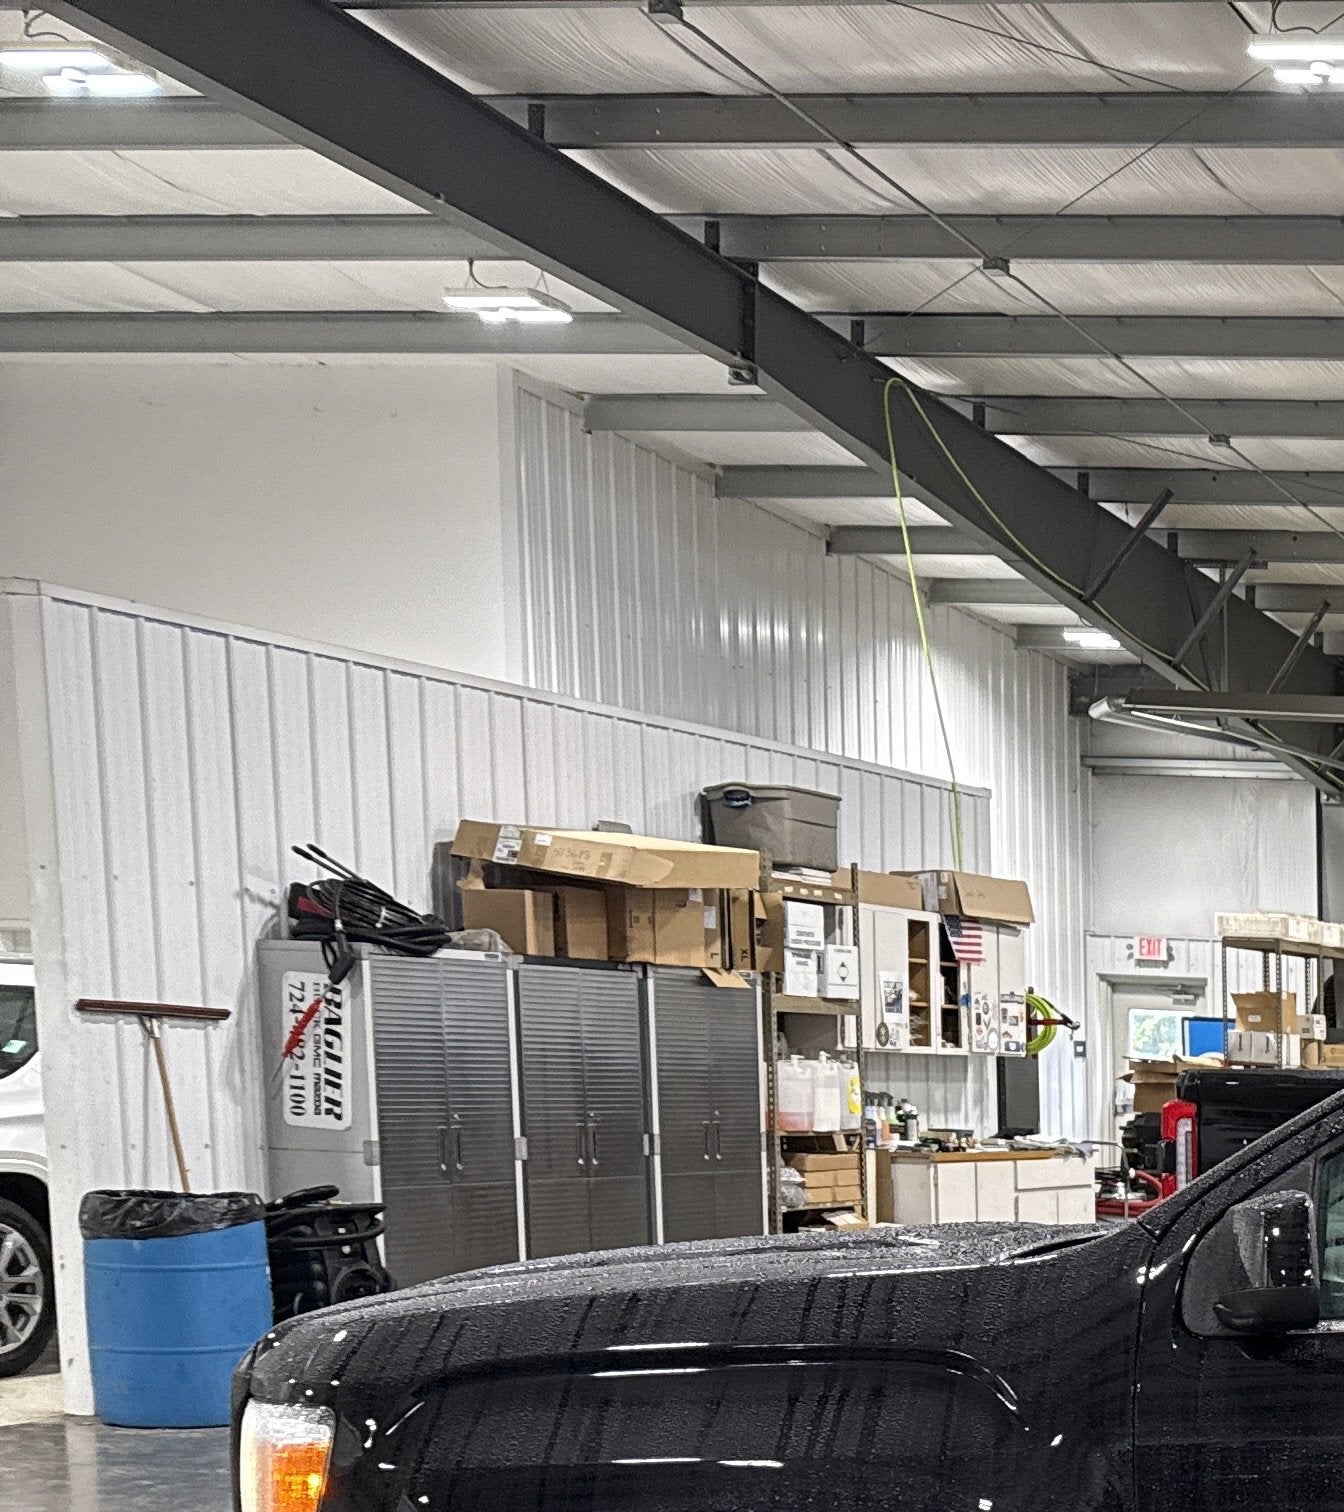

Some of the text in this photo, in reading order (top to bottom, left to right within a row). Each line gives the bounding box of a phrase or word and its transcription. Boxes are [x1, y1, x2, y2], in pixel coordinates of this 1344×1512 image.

[1139, 937, 1163, 957] EXIT
[288, 980, 307, 1118] 724-2-1100
[312, 1033, 322, 1069] GMC
[323, 981, 343, 1122] BAGLIER
